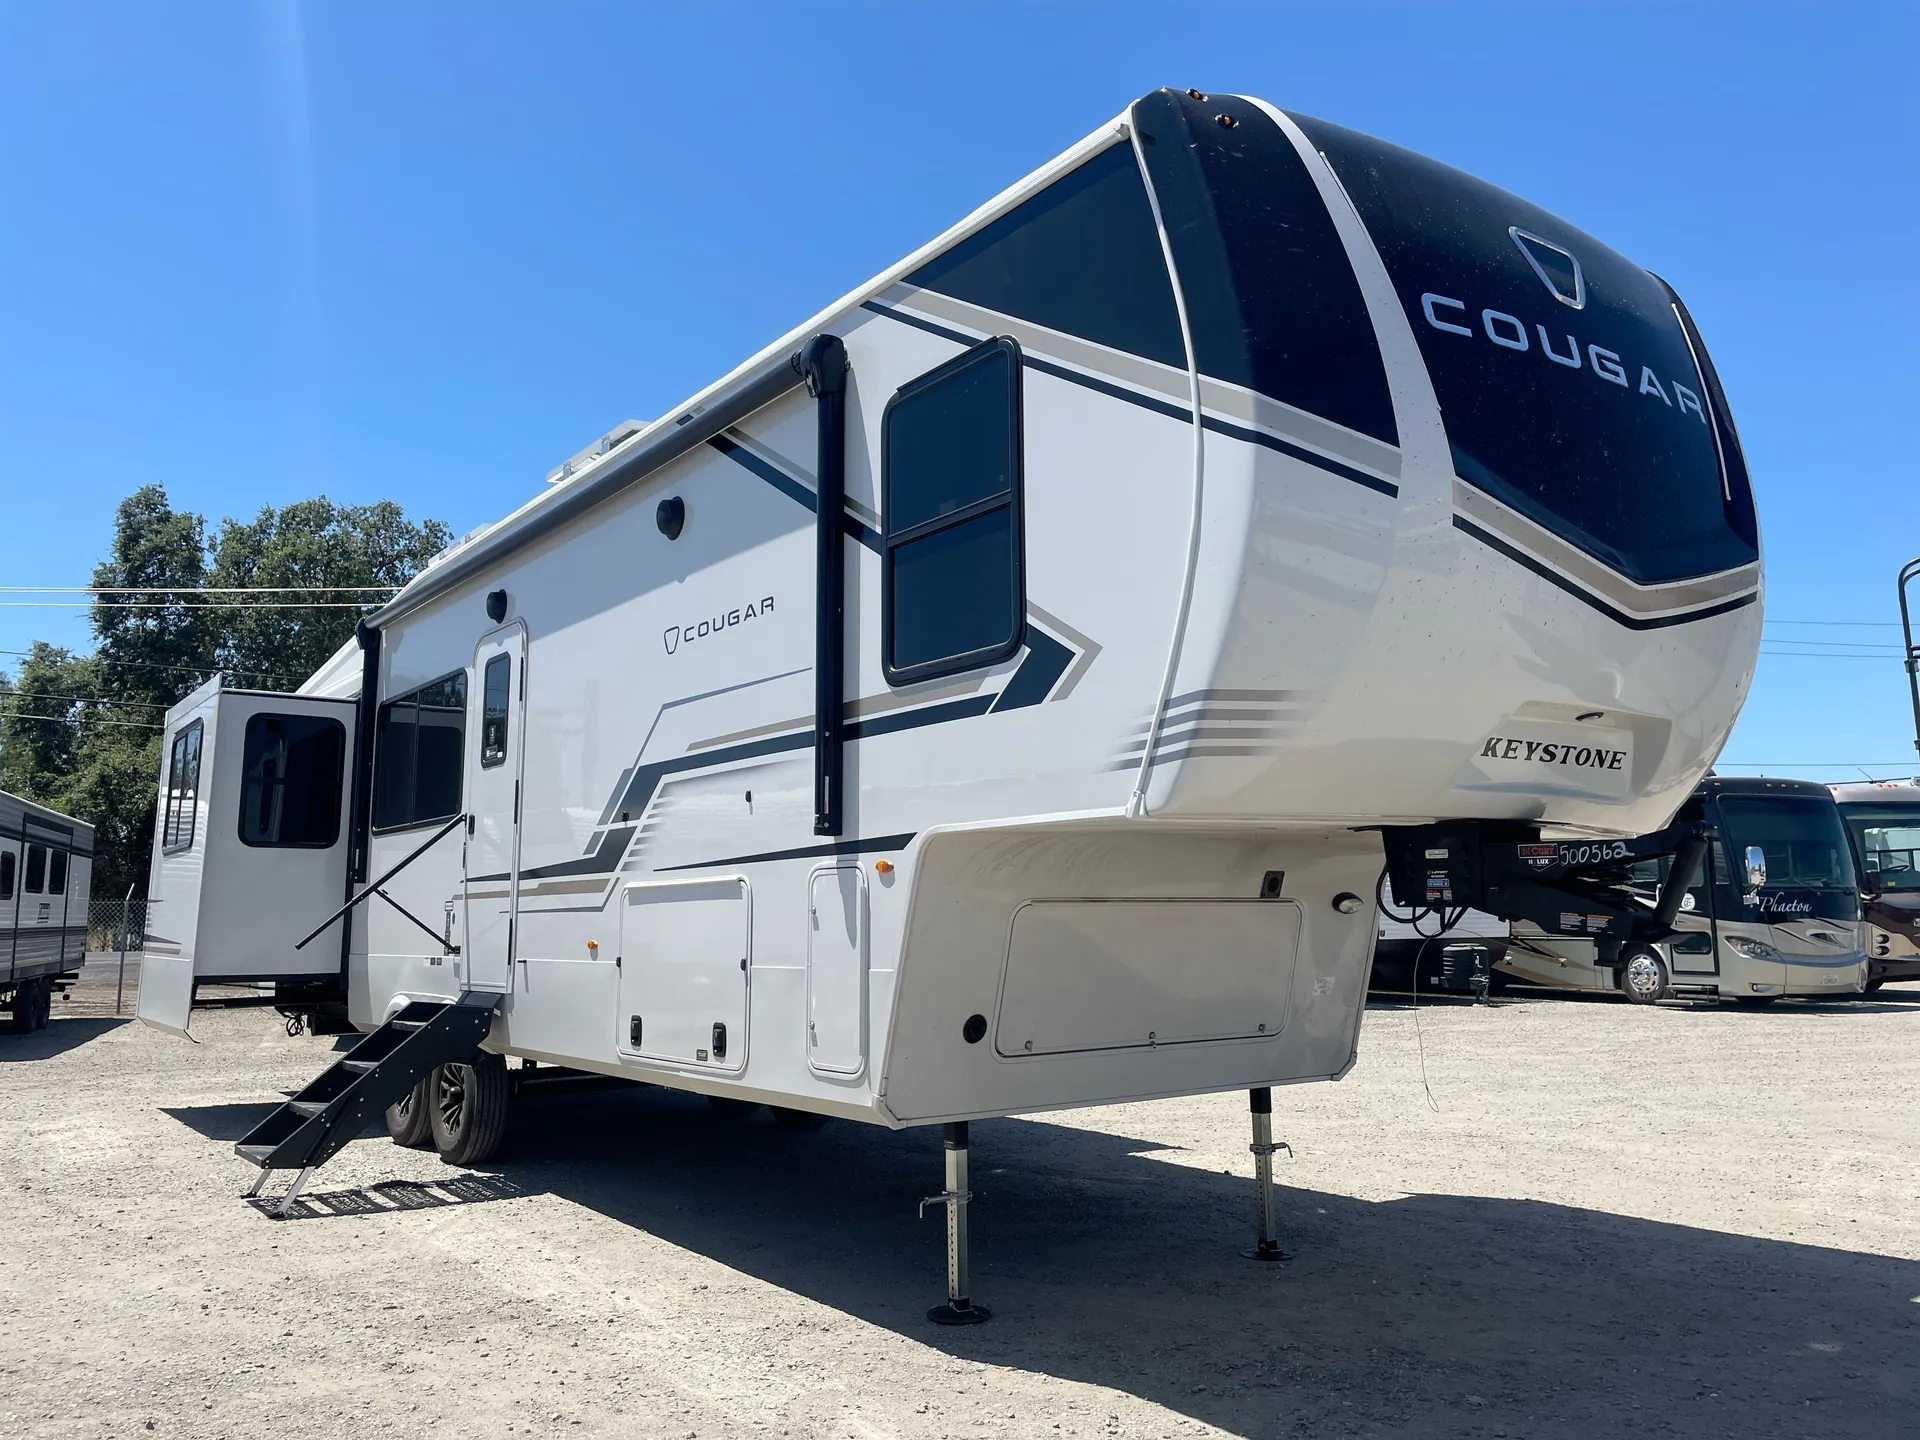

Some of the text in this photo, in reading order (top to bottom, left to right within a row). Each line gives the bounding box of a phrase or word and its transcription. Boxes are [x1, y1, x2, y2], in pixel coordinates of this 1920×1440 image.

[1421, 292, 1706, 425] COUGAR
[684, 595, 775, 643] COUGAR
[1480, 737, 1627, 770] KEYSTONE
[1560, 841, 1635, 866] 500562
[1760, 891, 1812, 912] Phaeton
